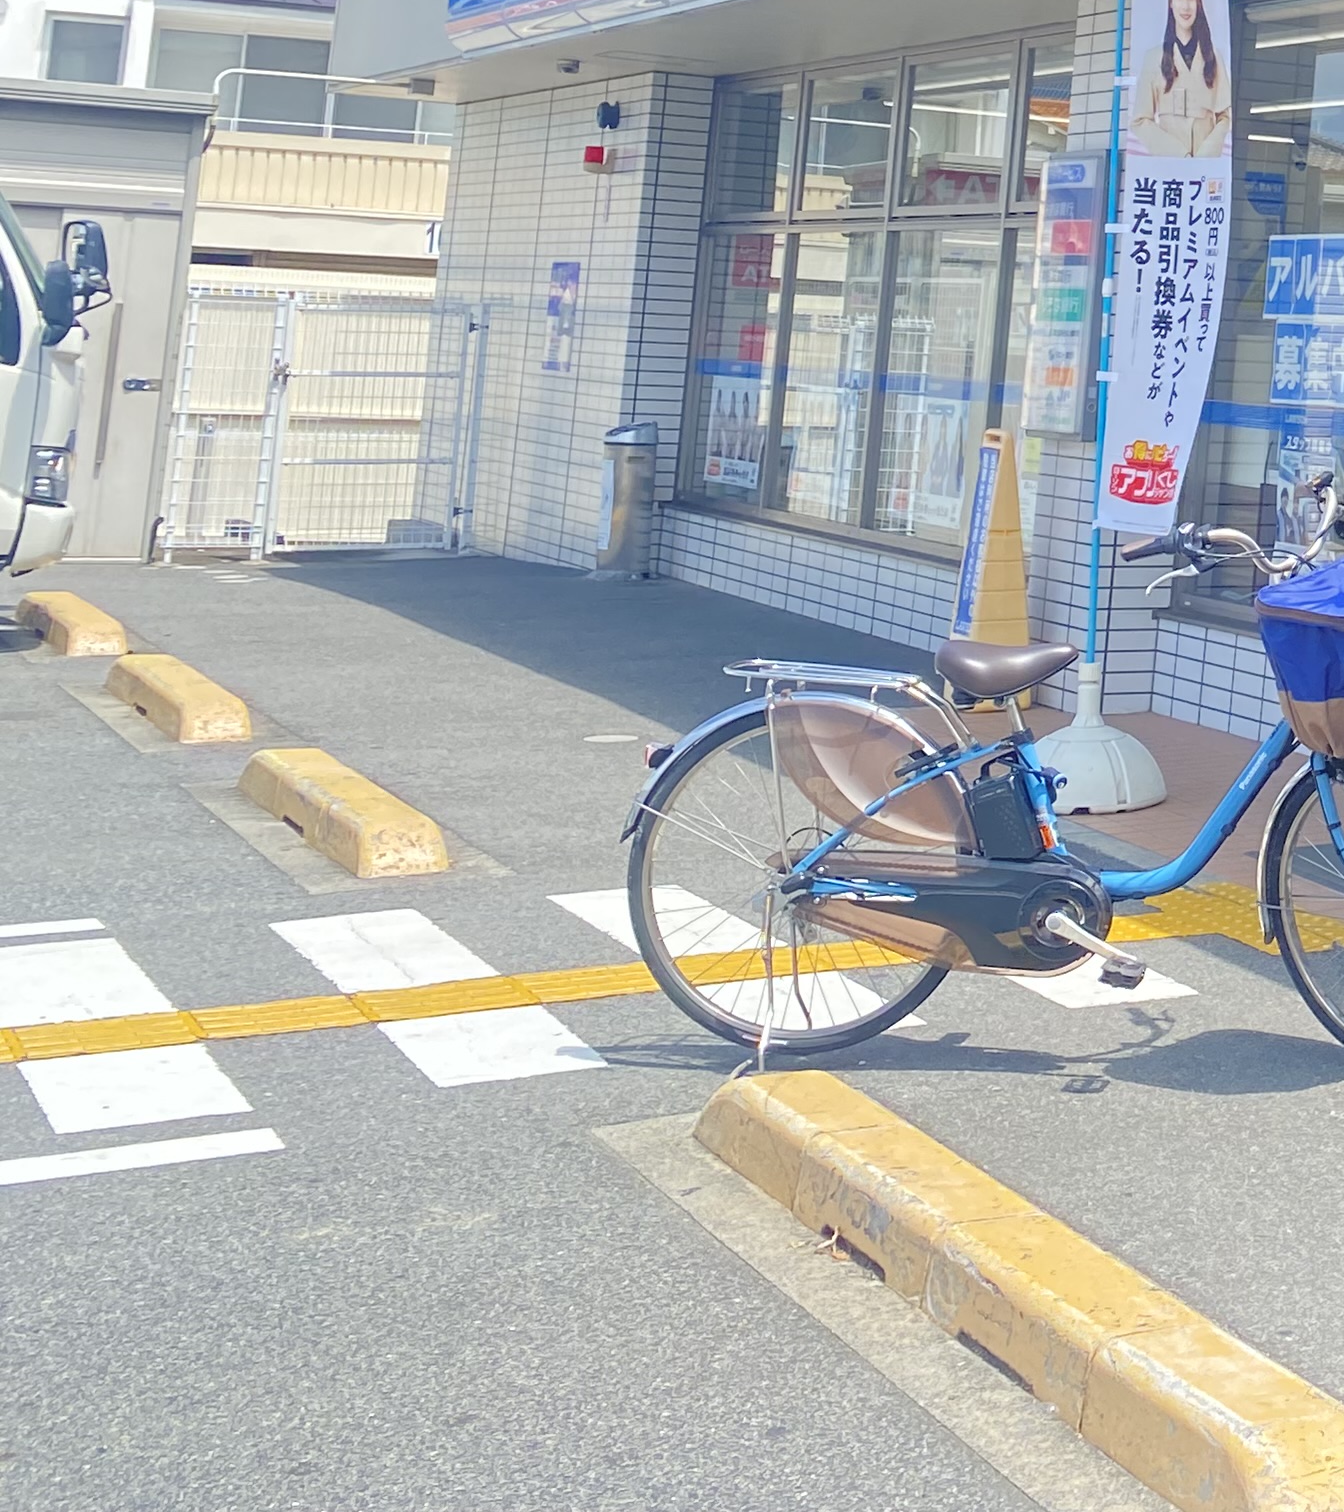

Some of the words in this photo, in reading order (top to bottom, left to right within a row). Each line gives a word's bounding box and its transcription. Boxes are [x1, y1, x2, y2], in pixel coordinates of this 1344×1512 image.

[1130, 178, 1157, 293] 当たる!
[1147, 179, 1184, 399] 商品引換券などが
[1164, 176, 1205, 427] プレミアムイベントや
[1120, 467, 1178, 498] アプリくじ
